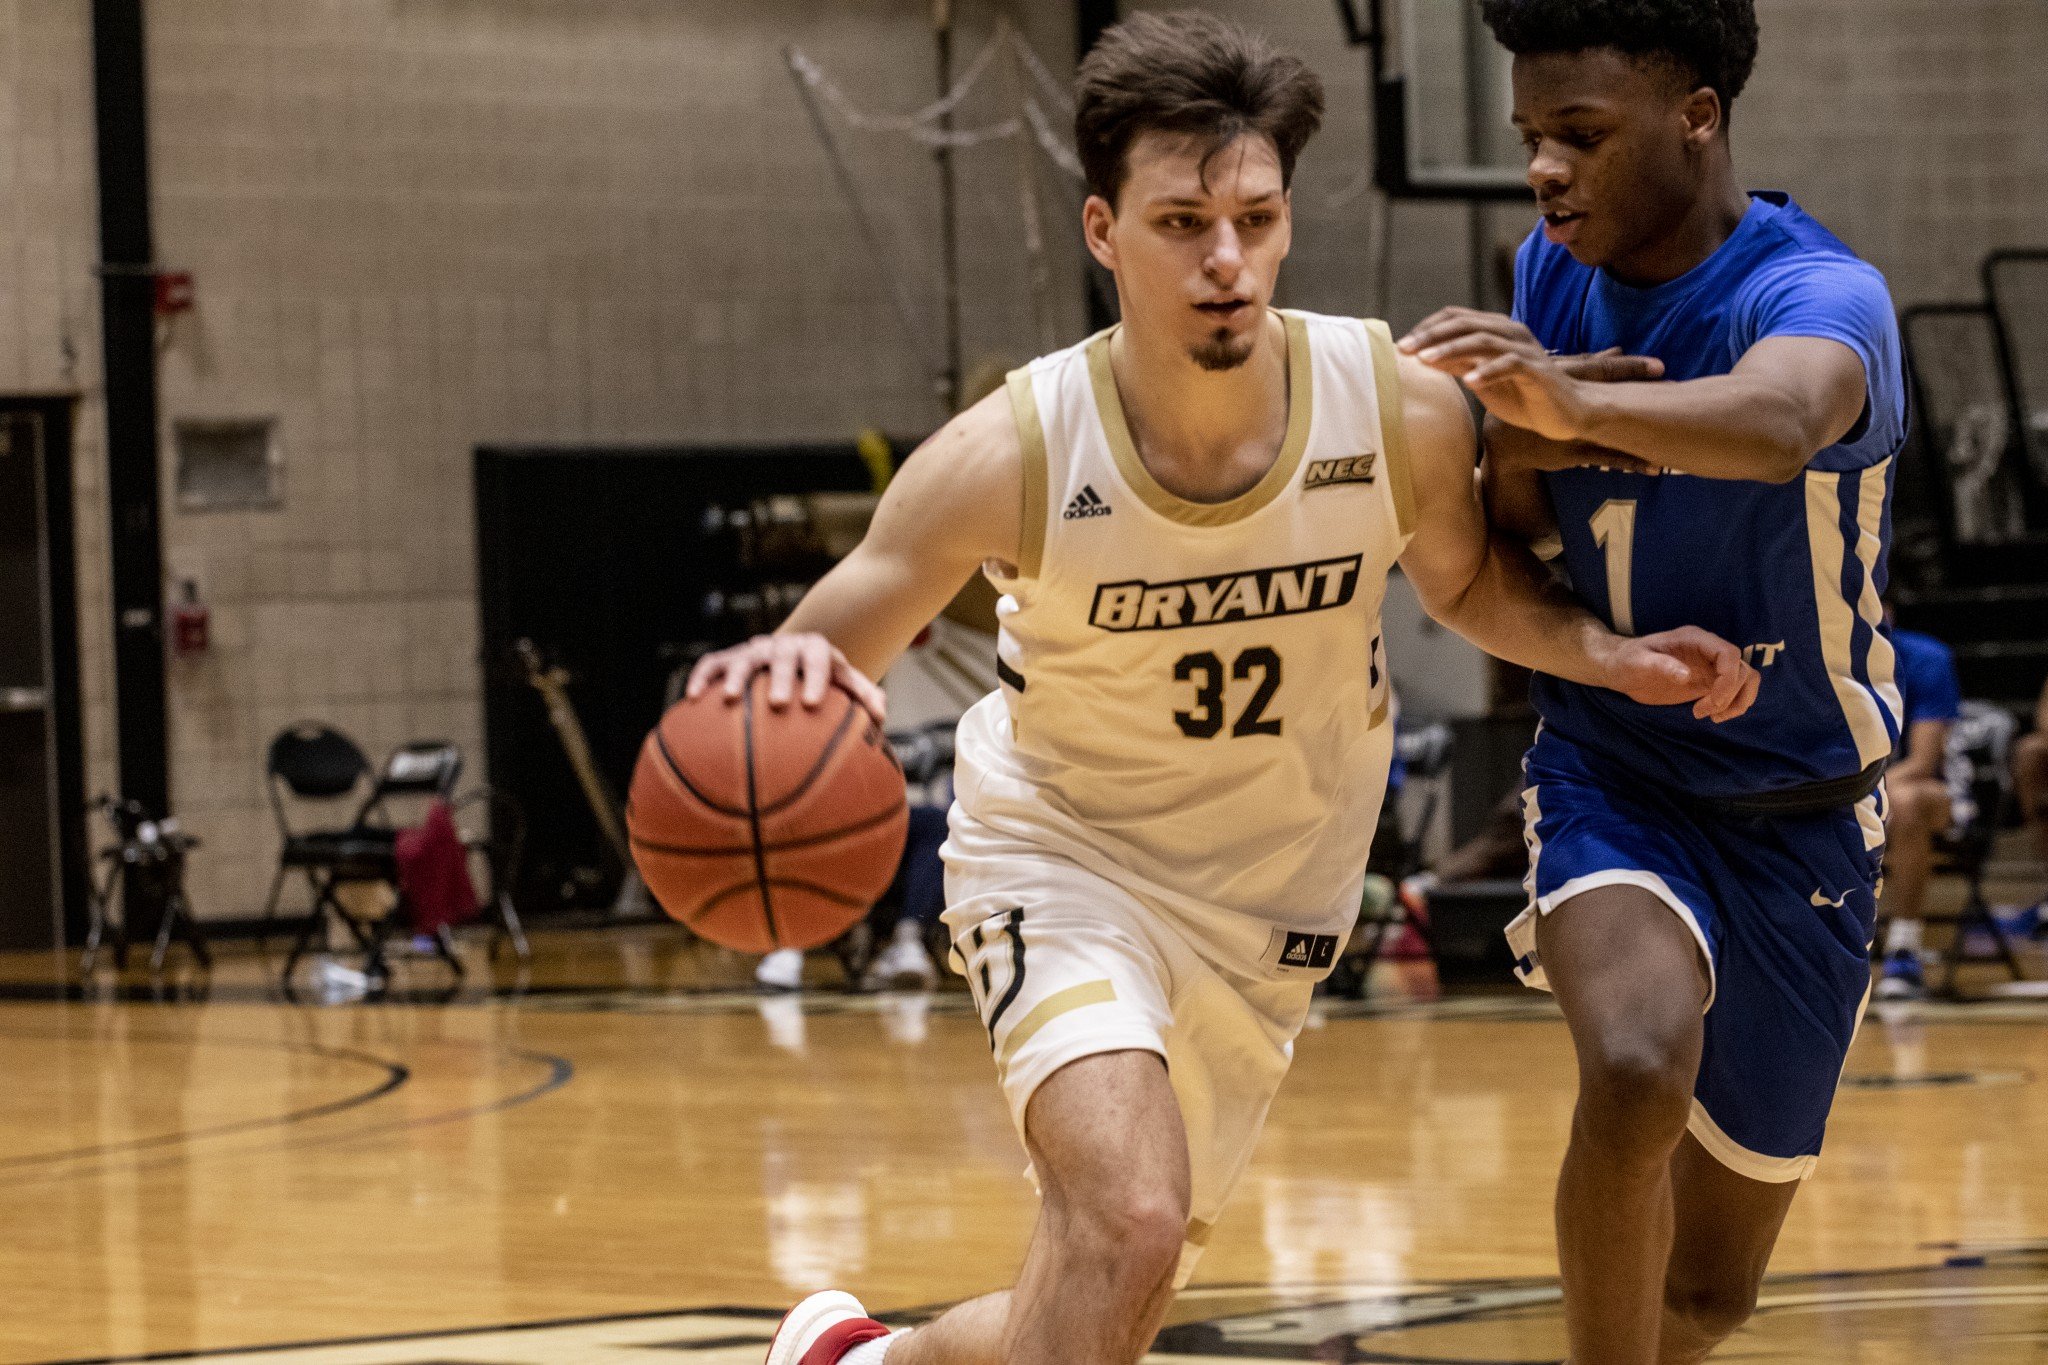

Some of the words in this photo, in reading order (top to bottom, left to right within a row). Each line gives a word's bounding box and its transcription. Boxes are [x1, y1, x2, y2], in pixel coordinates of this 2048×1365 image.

[1305, 453, 1376, 483] NEC
[1063, 504, 1112, 519] adidas
[1091, 557, 1360, 630] BRYANT
[1588, 499, 1637, 635] 1
[1173, 645, 1283, 739] 32
